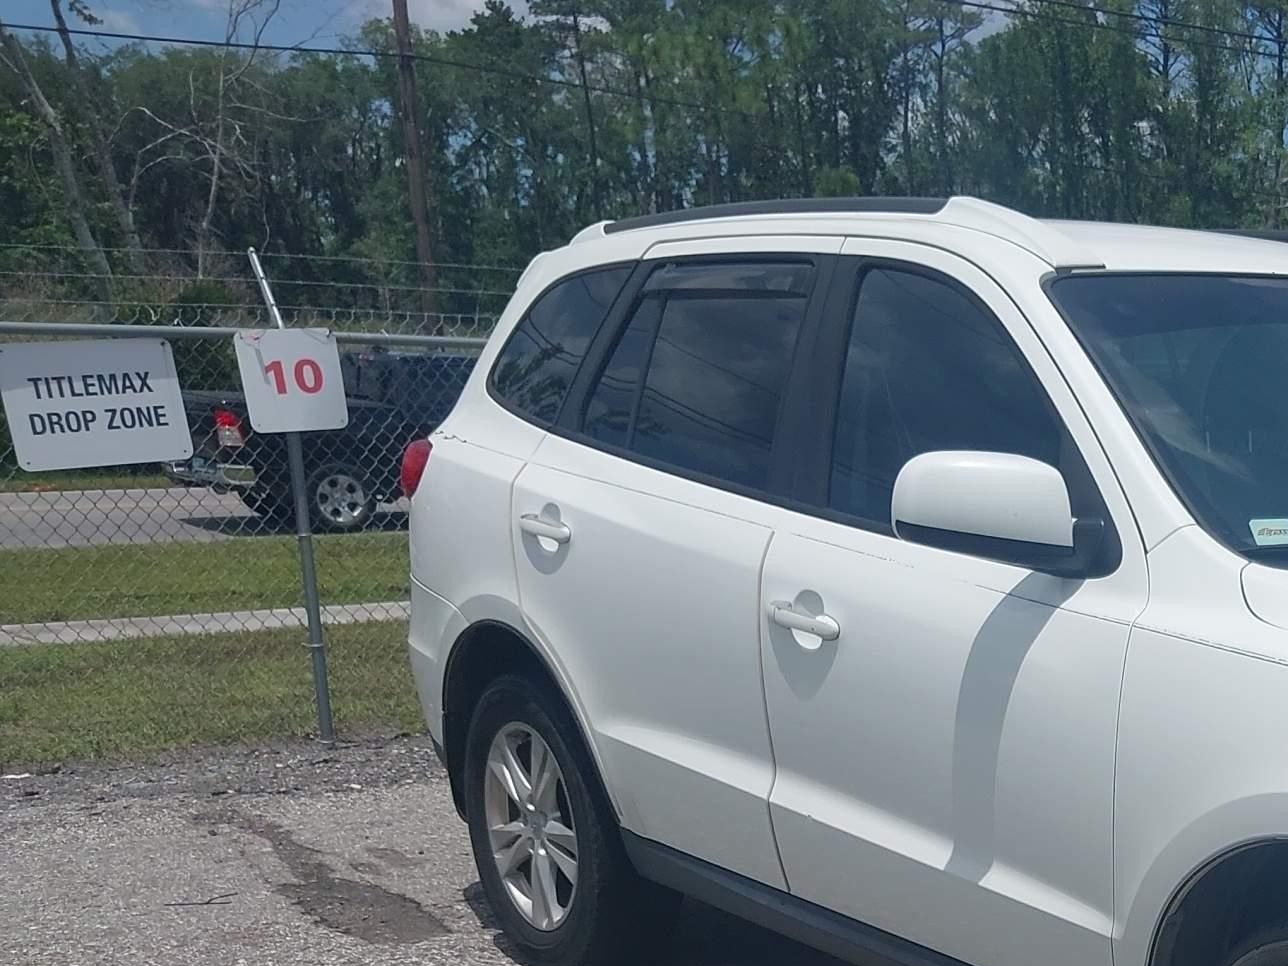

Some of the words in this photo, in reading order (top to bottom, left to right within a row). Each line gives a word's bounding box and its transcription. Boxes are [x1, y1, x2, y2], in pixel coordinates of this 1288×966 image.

[27, 371, 154, 400] TITLEMAX
[264, 359, 324, 395] 10
[28, 410, 97, 436] DROP
[104, 405, 170, 430] ZONE
